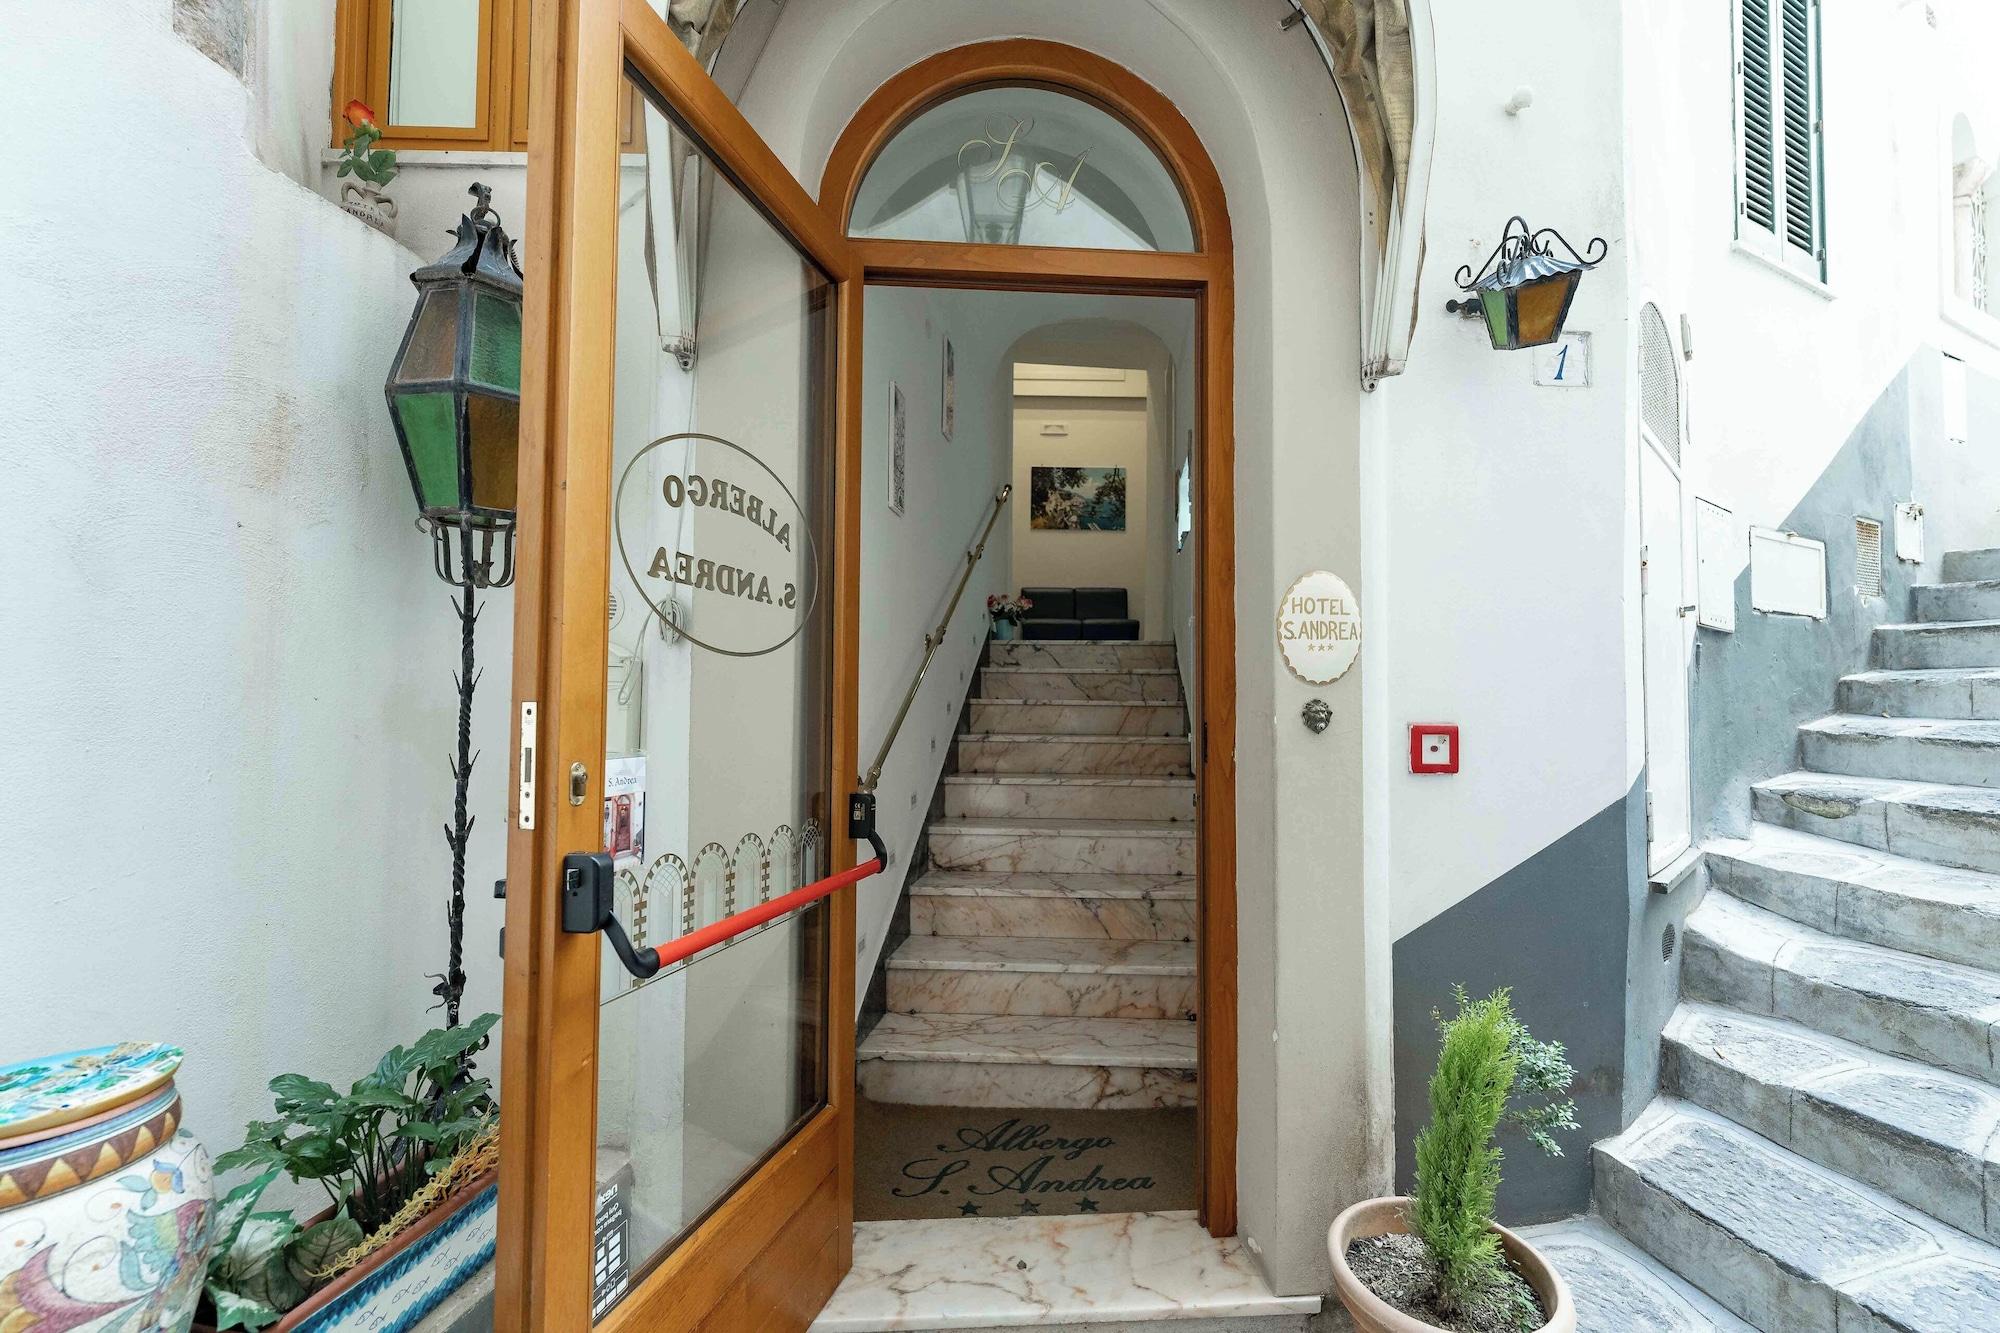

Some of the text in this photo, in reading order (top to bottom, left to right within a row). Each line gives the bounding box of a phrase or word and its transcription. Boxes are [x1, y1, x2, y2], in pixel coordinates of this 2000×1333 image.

[1553, 344, 1568, 380] 1
[1291, 596, 1350, 616] HOTEL
[937, 1119, 1116, 1161] Albergo
[968, 1155, 1156, 1195] Andrea
